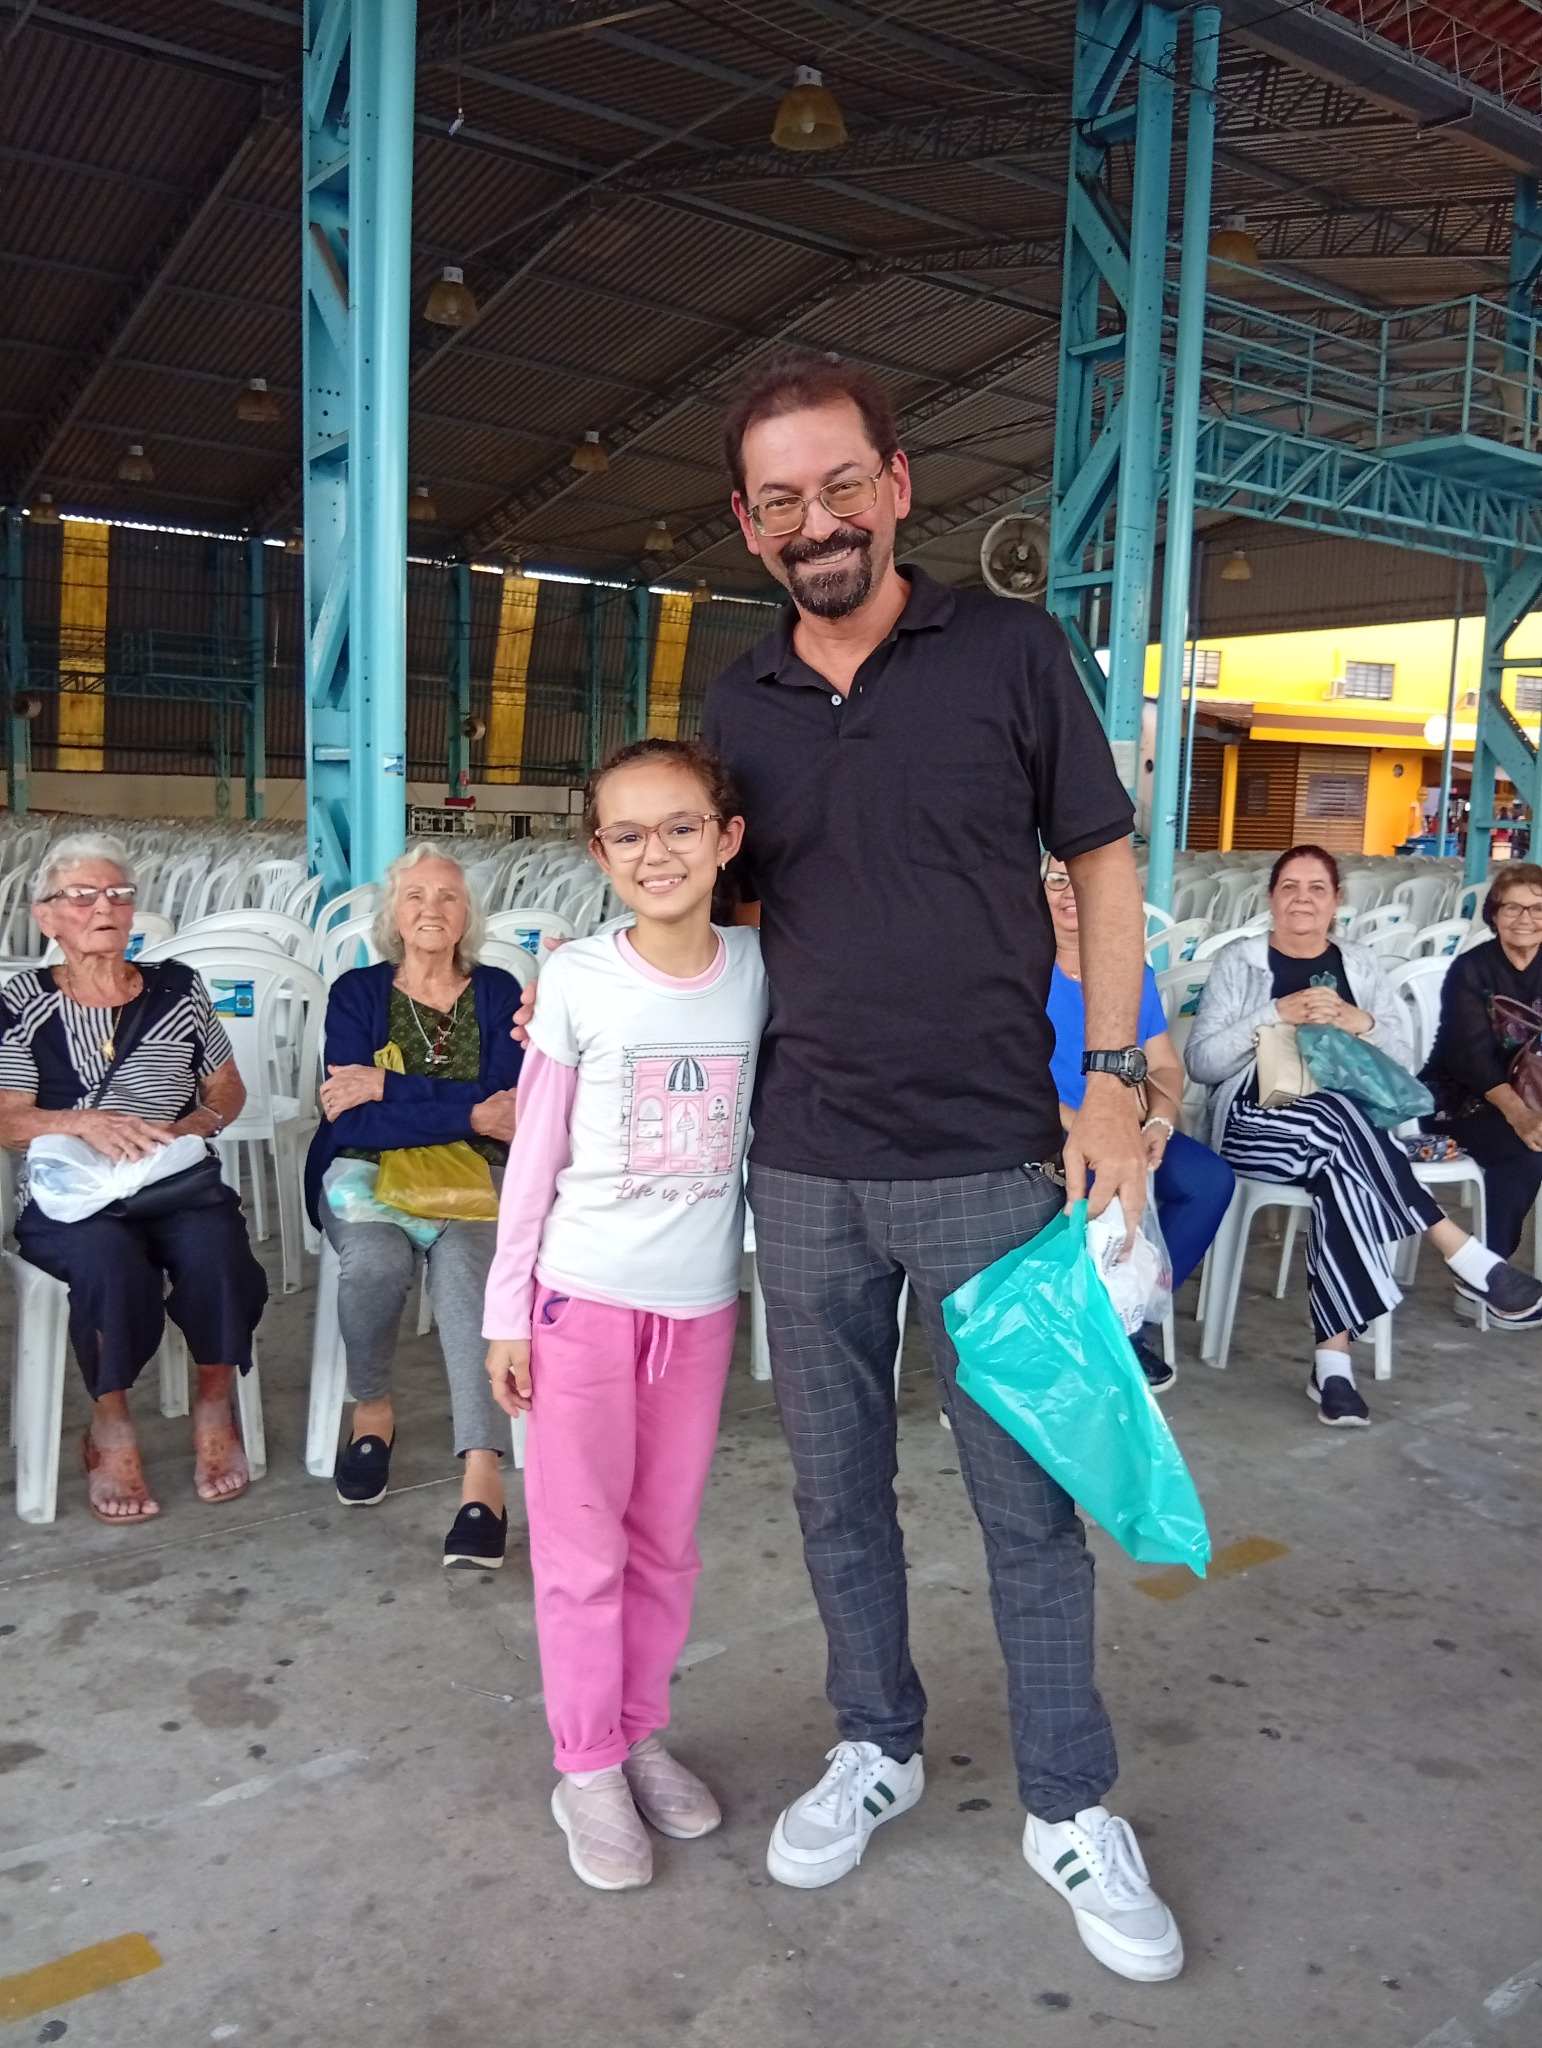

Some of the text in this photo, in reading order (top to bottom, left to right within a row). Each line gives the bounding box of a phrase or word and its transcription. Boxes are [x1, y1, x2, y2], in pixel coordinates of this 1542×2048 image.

[615, 1179, 730, 1205] Life is Sweet
